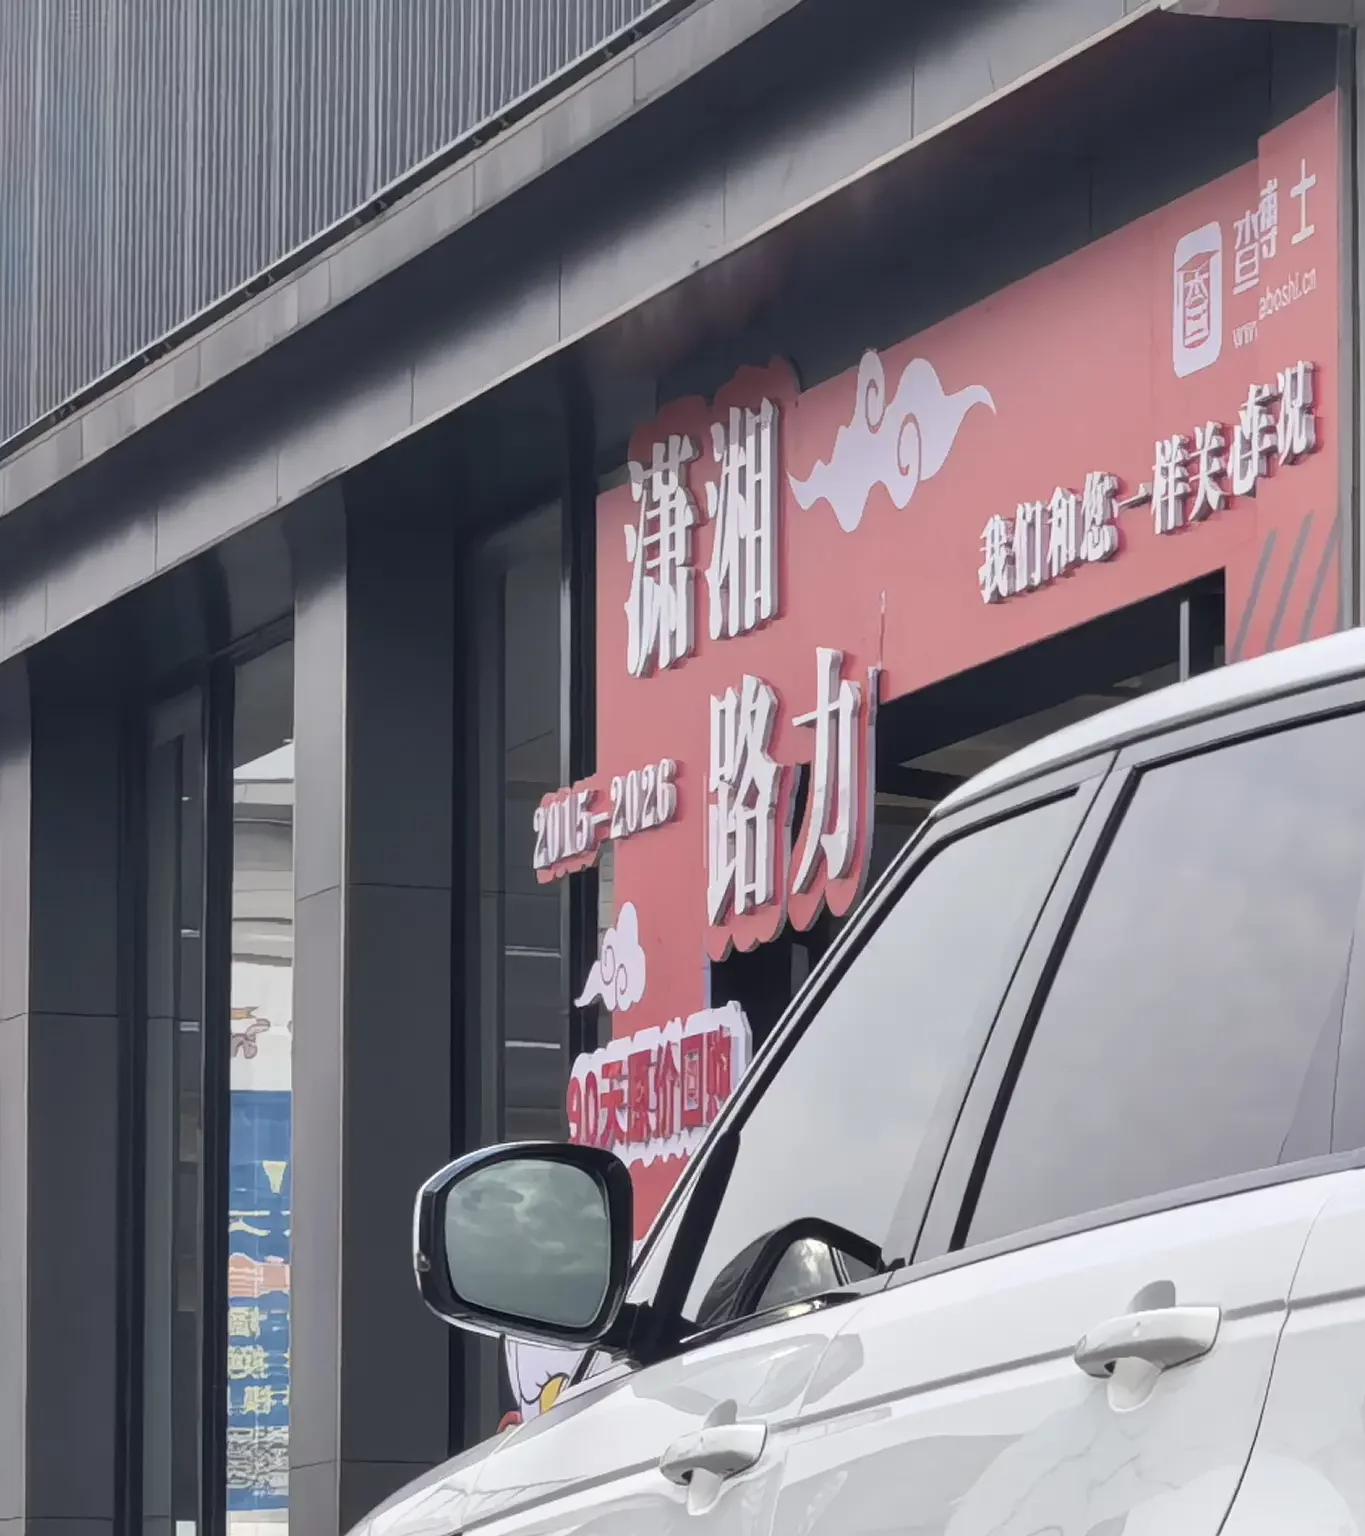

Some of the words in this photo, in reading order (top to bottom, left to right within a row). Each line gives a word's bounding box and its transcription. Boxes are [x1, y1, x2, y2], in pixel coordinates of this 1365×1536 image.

[623, 396, 782, 680] 潇湘
[977, 360, 1315, 606] 我们和您一样关心车况
[532, 758, 678, 870] 2015-2026
[706, 645, 864, 927] 路力
